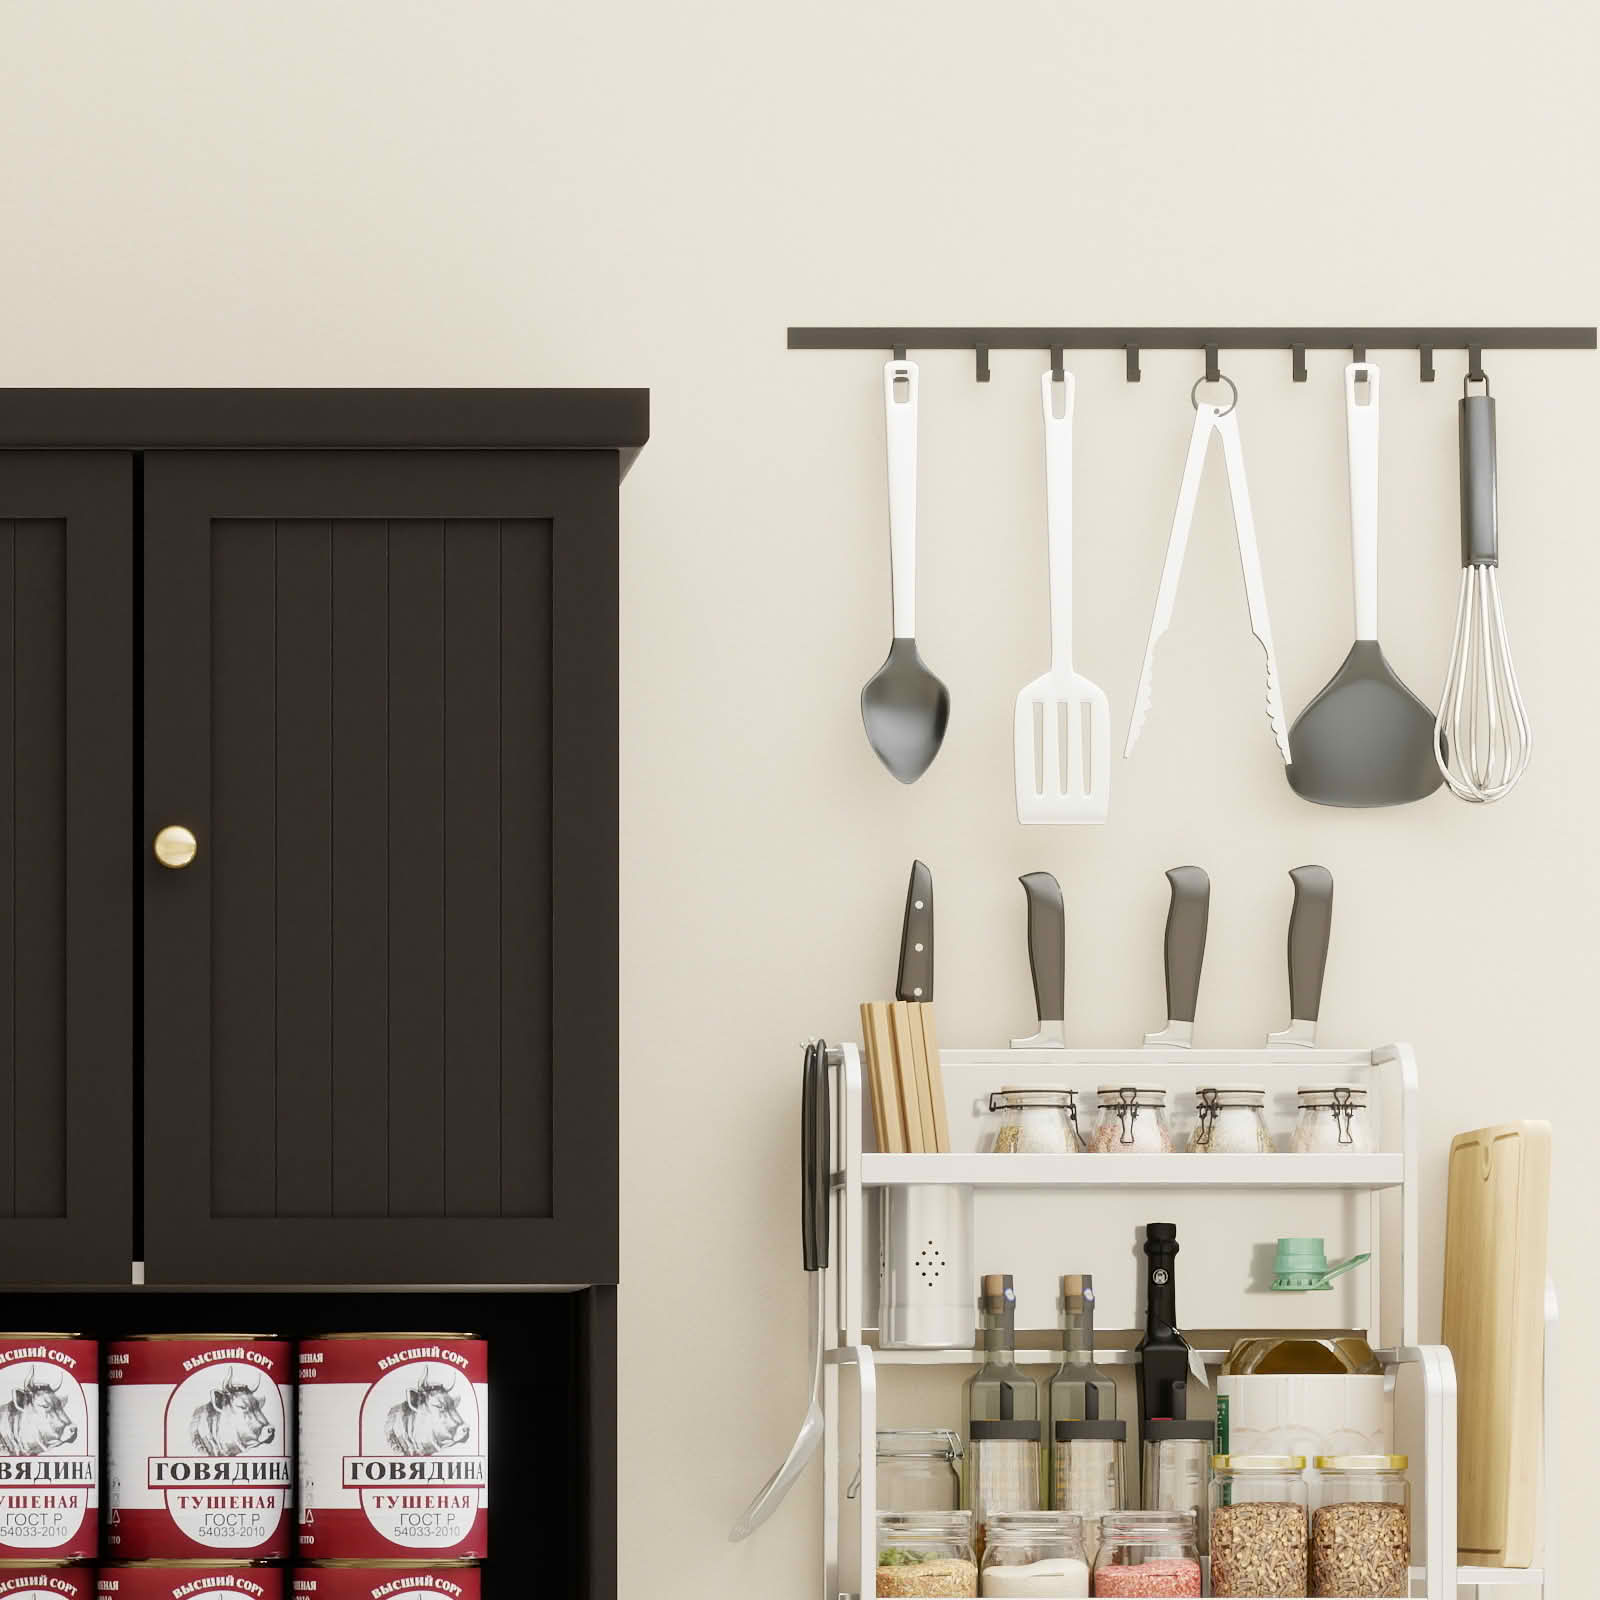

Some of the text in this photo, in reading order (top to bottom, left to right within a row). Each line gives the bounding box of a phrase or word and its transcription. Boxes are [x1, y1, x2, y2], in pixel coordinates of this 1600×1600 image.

[47, 1349, 77, 1369] СОРТ
[182, 1347, 274, 1371] ВЫСШИЙ СОРТ
[377, 1346, 470, 1370] ВЫСШИЙ СОРТ
[157, 1462, 291, 1482] ГОВЯДИНА
[352, 1462, 484, 1482] ГОВЯДИНА
[178, 1496, 275, 1509] ТУШЕНАЯ
[373, 1496, 471, 1508] ТУШЕНАЯ
[6, 1513, 63, 1525] ГОСТ Р
[204, 1513, 260, 1526] ГОСТ Р
[399, 1513, 456, 1525] ГОСТ Р
[0, 1526, 68, 1537] 54033-2010
[198, 1527, 266, 1538] 54033-2010
[393, 1526, 462, 1537] 54033-2010
[48, 1577, 78, 1597] СОРТ
[172, 1574, 265, 1599] ВЫСШИЙ СОРТ
[371, 1575, 464, 1600] ВЫСШИЙ СОРТ
